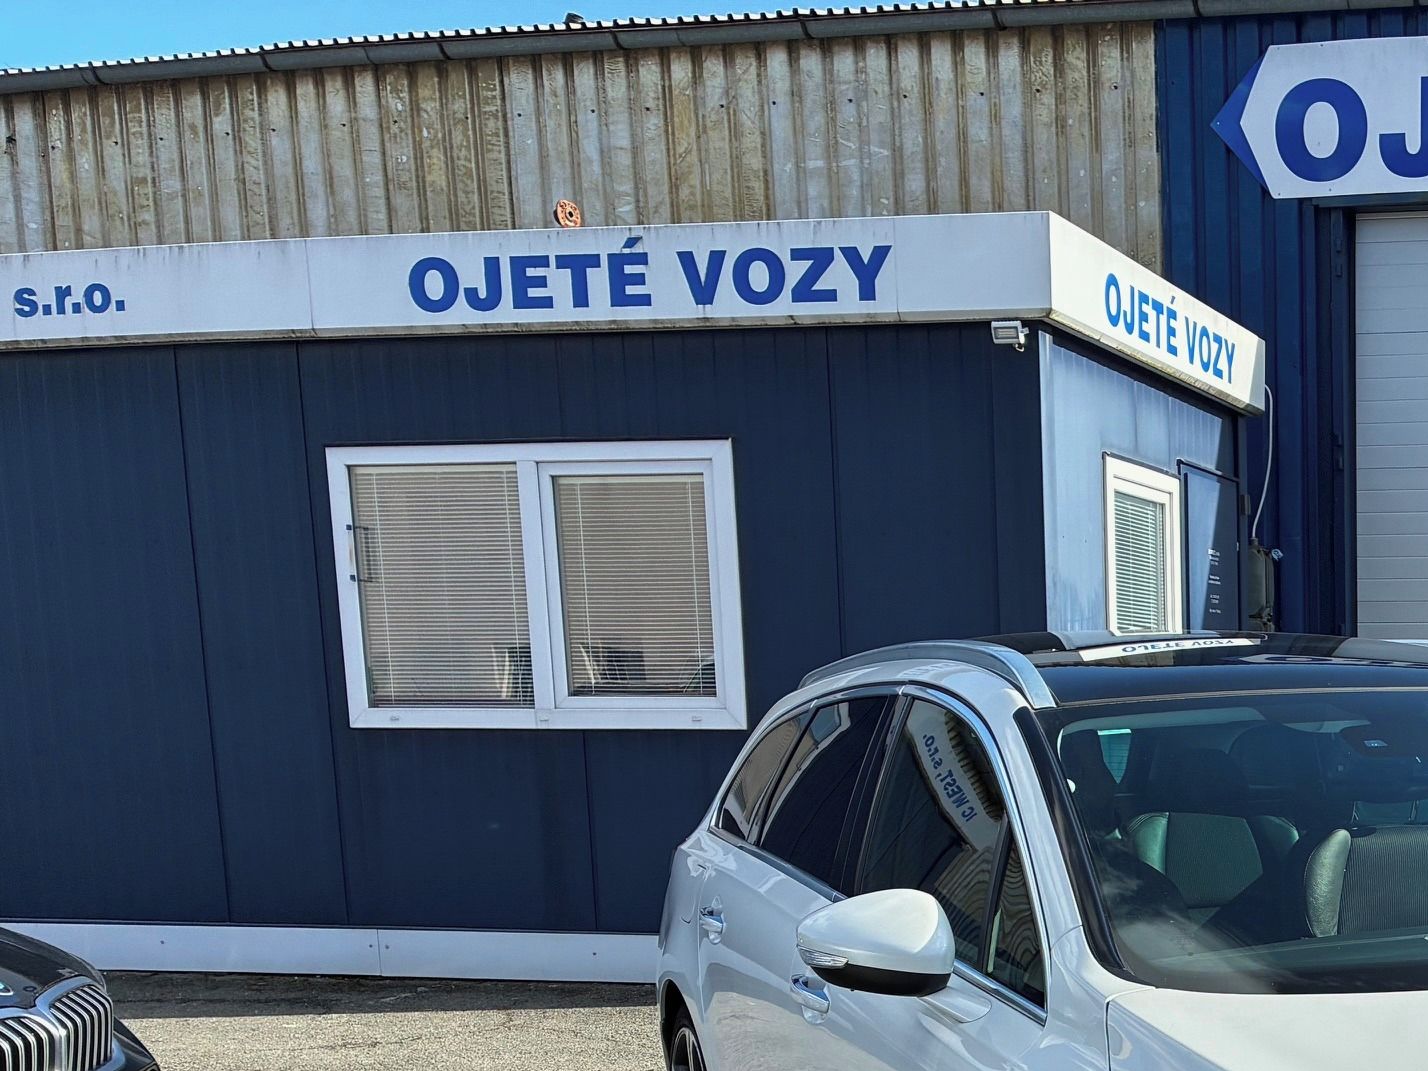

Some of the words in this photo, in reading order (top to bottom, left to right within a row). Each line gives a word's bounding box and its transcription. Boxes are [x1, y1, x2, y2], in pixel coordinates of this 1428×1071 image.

[13, 283, 126, 318] s.r.o.
[409, 236, 653, 314] OJETÉ
[676, 245, 893, 306] VOZY
[1104, 272, 1178, 358] OJETÉ
[1184, 315, 1236, 385] VOZY
